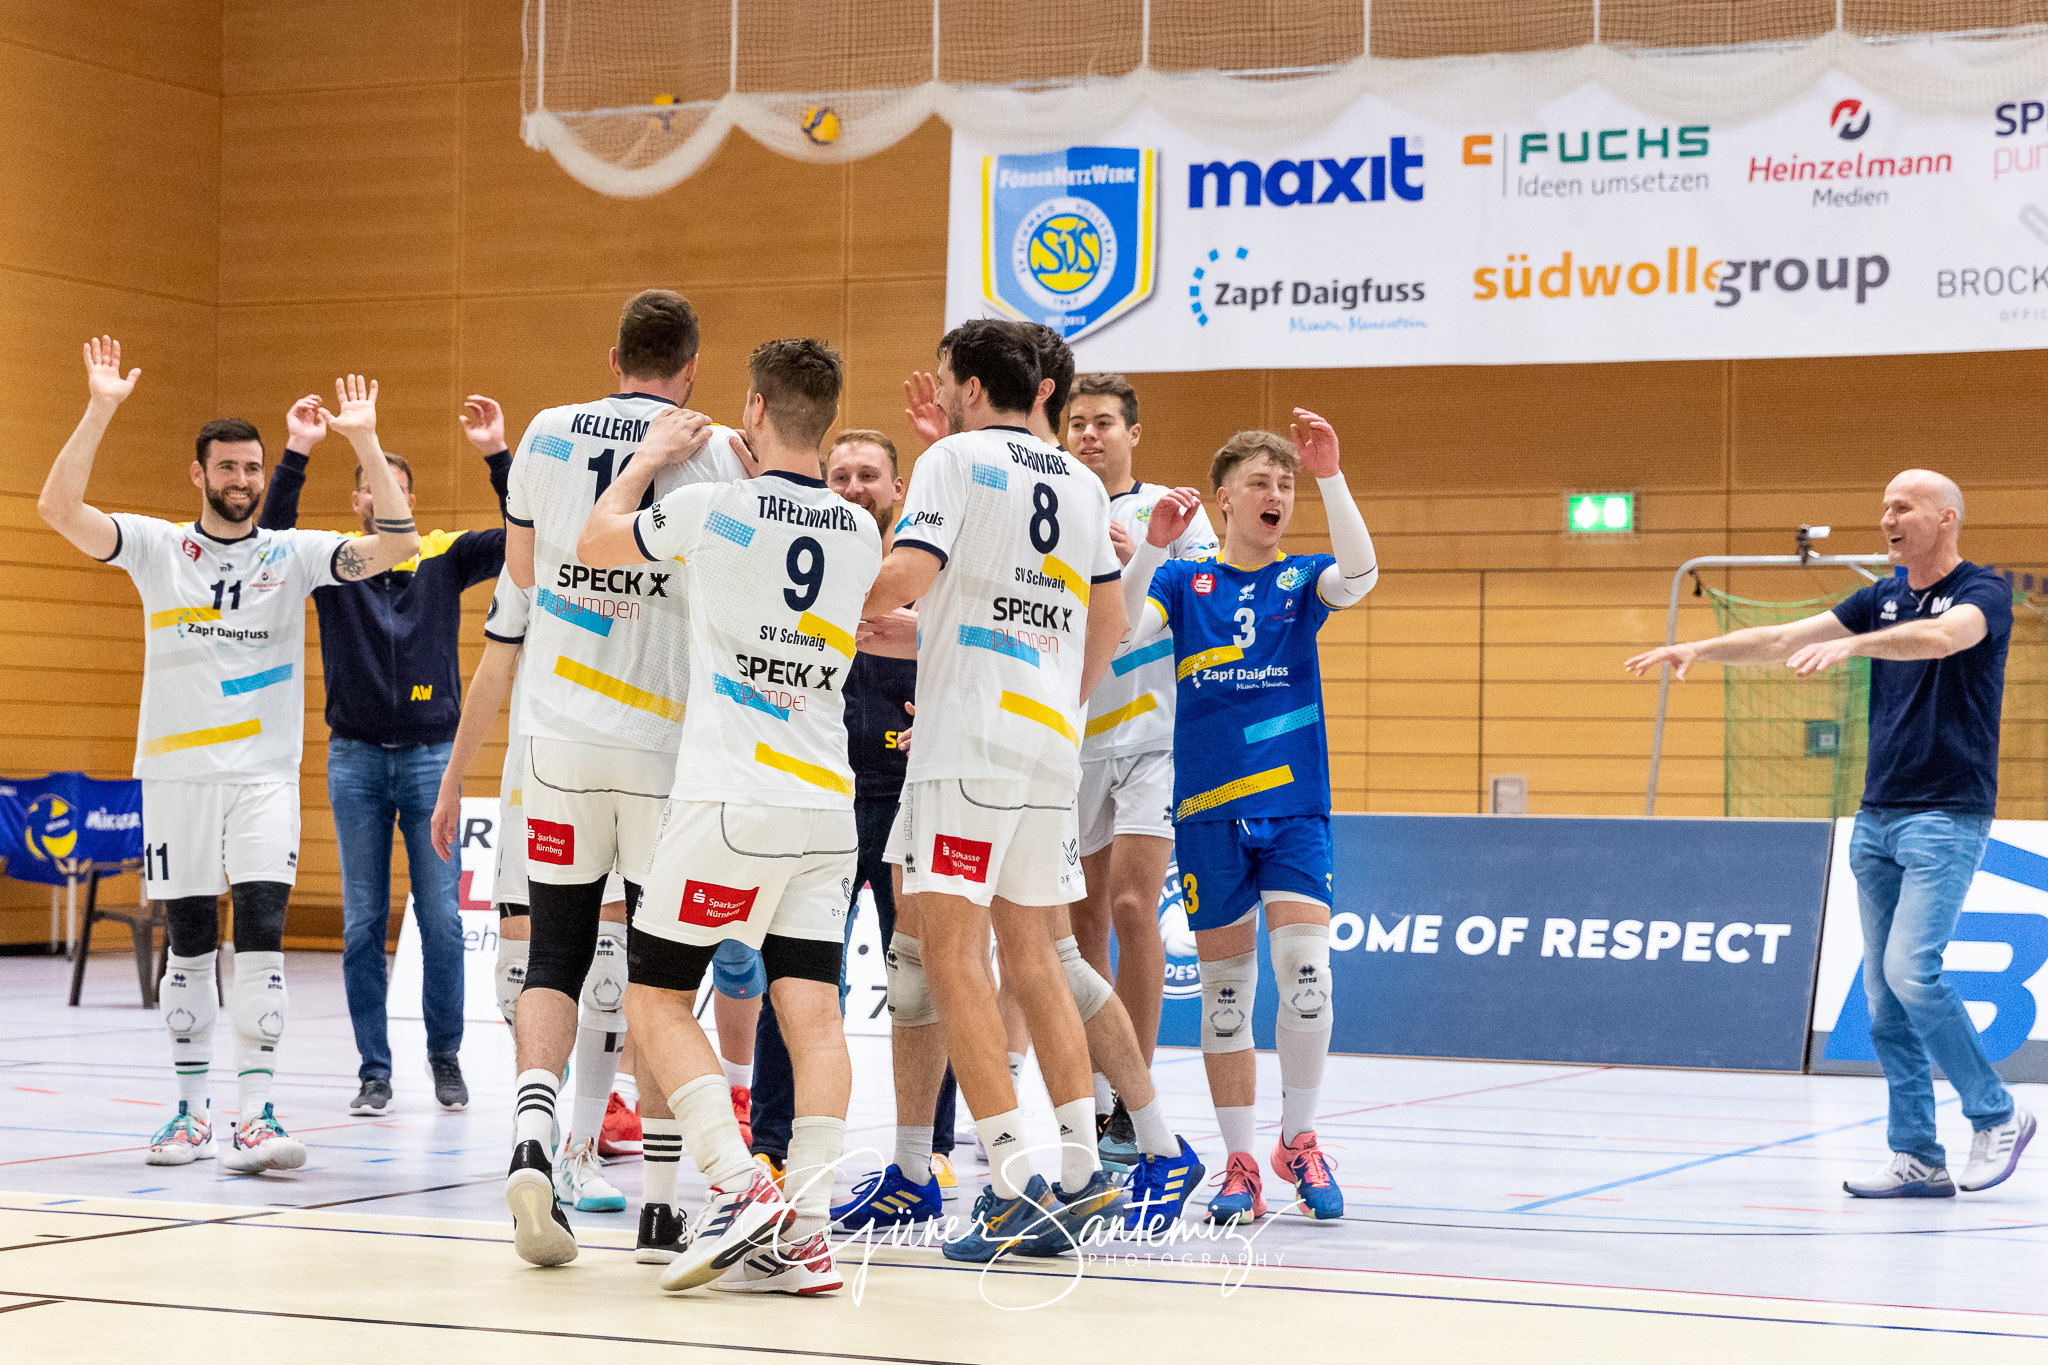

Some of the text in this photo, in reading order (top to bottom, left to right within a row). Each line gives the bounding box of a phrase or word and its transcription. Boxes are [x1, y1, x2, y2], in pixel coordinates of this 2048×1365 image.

[1994, 101, 2048, 137] SP
[1519, 125, 1710, 164] FUCHS
[1189, 135, 1424, 208] maxit
[1517, 170, 1710, 197] Ideen umsetzen
[1748, 152, 1953, 184] Heinzelmann
[1812, 186, 1889, 207] Medien
[1215, 277, 1425, 311] Zapf Daigfuss
[1007, 441, 1070, 476] SCHWABE
[758, 495, 858, 532] TAFELMAYER
[914, 511, 944, 526] puls
[1030, 482, 1060, 554] 8
[557, 563, 644, 596] SPECK
[783, 536, 825, 612] 9
[1015, 567, 1066, 593] SV Schwaig
[210, 579, 242, 610] 11
[556, 593, 640, 622] pumpen
[993, 597, 1059, 629] SPECK
[1233, 607, 1256, 649] 3
[188, 622, 269, 641] Zapf Daigfuss
[760, 625, 826, 651] SV Schwaig
[993, 628, 1059, 654] pumpen
[736, 654, 814, 688] SPECK
[1203, 665, 1289, 682] Zapf Daigfuss
[410, 684, 433, 701] AW
[146, 842, 169, 881] 11
[1183, 872, 1200, 914] 3
[1455, 915, 1529, 956] OF
[1540, 917, 1792, 965] RESPECT
[1165, 963, 1201, 981] DES
